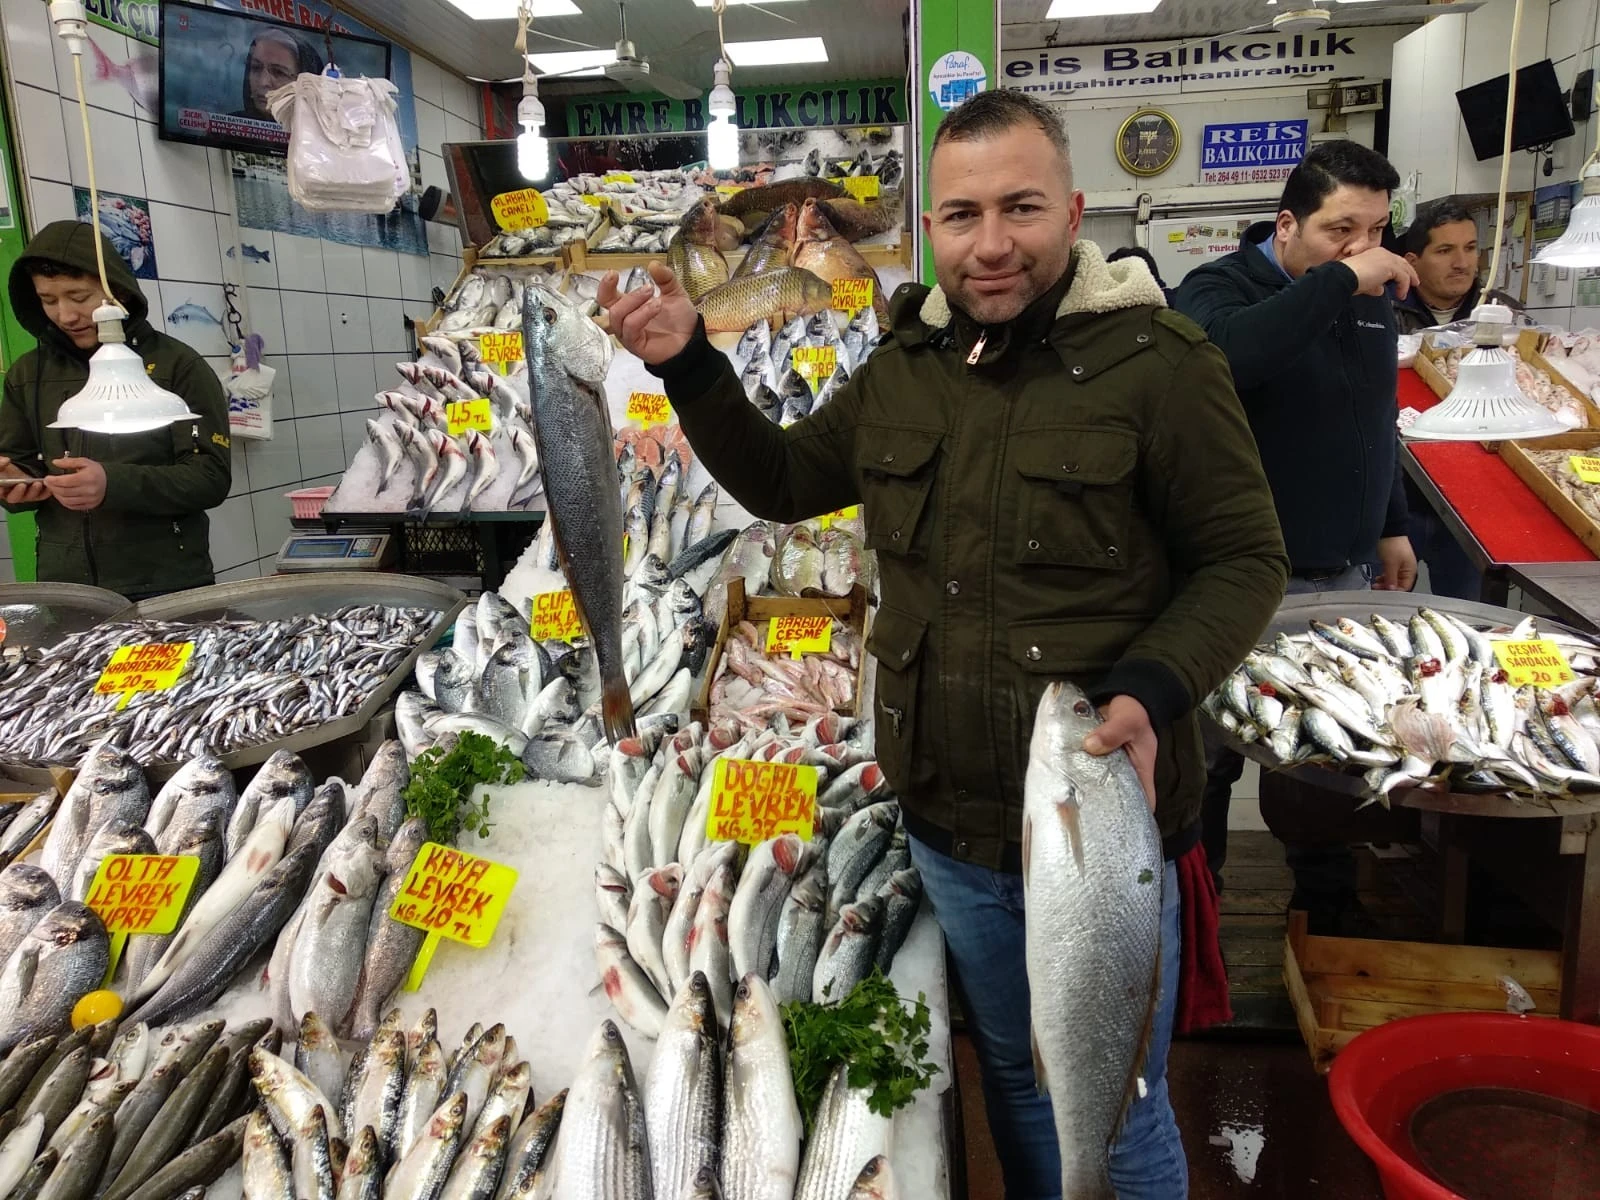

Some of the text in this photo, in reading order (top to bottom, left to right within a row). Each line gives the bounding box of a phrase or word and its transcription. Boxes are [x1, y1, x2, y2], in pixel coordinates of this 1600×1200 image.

[1002, 53, 1082, 78] eis
[576, 86, 898, 137] EMRE BLIKCILIK
[1208, 122, 1302, 145] REİS
[1204, 143, 1304, 165] BALIKÇILIK
[1218, 171, 1230, 182] 264
[1231, 170, 1239, 181] 49
[1252, 169, 1267, 180] 0532
[1269, 168, 1281, 179] 523
[832, 278, 870, 294] SAZAN
[482, 332, 521, 347] OLTA
[481, 346, 523, 363] LEVREK
[537, 590, 575, 615] ÇUP
[776, 616, 832, 630] BARBUN
[1505, 655, 1561, 668] SARDALYA
[119, 674, 142, 689] 20
[142, 678, 157, 690] TL
[1531, 670, 1552, 683] 20
[714, 790, 815, 823] LEVREK
[105, 856, 180, 882] OLTA
[422, 845, 492, 887] KAYA
[87, 882, 182, 908] LEVREK
[405, 872, 495, 920] LEVREK
[94, 906, 159, 930] UPRA
[421, 904, 453, 928] 40
[453, 921, 472, 941] TL
